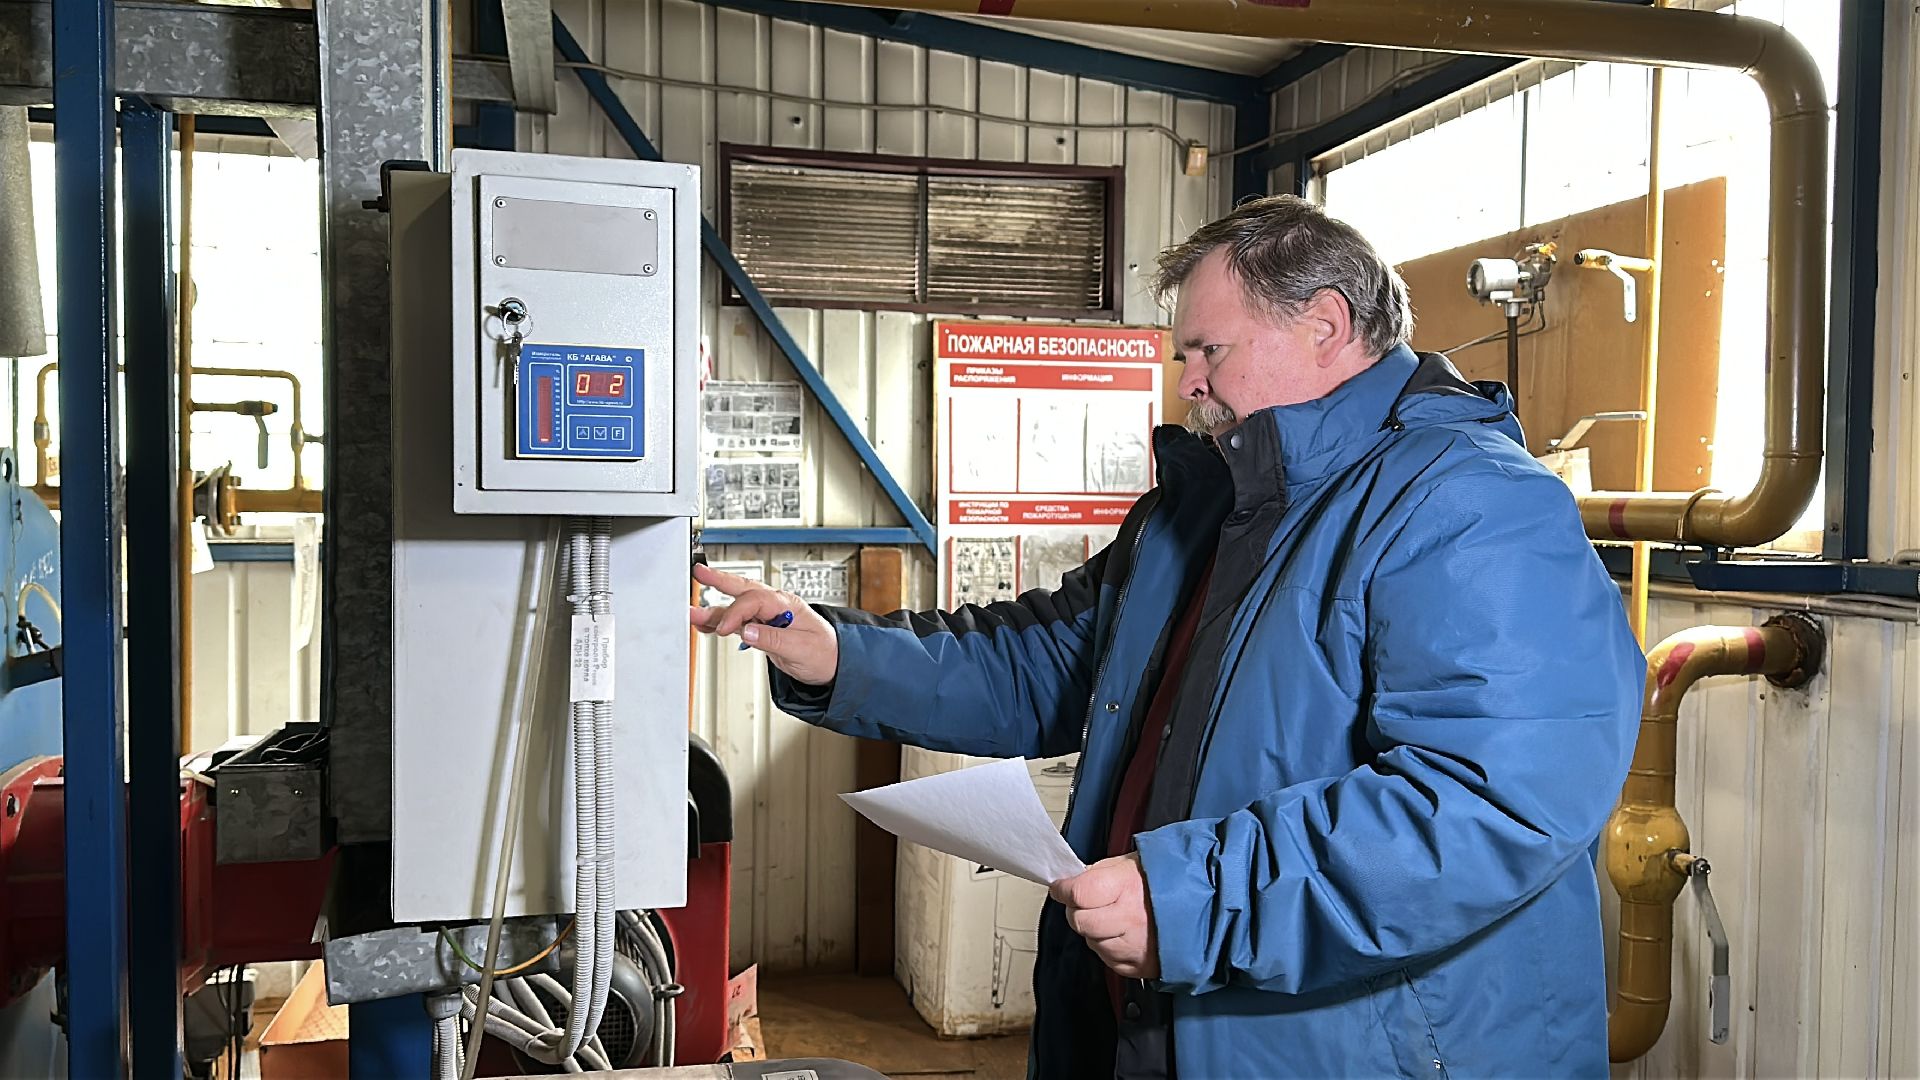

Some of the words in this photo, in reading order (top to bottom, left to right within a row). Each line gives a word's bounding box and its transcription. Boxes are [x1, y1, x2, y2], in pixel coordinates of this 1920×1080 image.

[948, 334, 1034, 355] ПОЖАРНАЯ
[1038, 337, 1156, 358] БЕЗОПАСНОСТЬ
[567, 353, 579, 361] КБ
[966, 366, 1004, 375] ПРИКАЗЫ
[953, 374, 1016, 384] РАСПОРЯЖЕНИЯ
[1061, 373, 1113, 382] ИНФОРМАЦИЯ
[576, 374, 590, 394] 0
[609, 374, 624, 395] 2
[959, 515, 1009, 523] БЕЗОПАСНОСТИ
[1022, 512, 1082, 520] ПОЖАРОТУШЕНИЯ
[601, 637, 609, 669] Прибор
